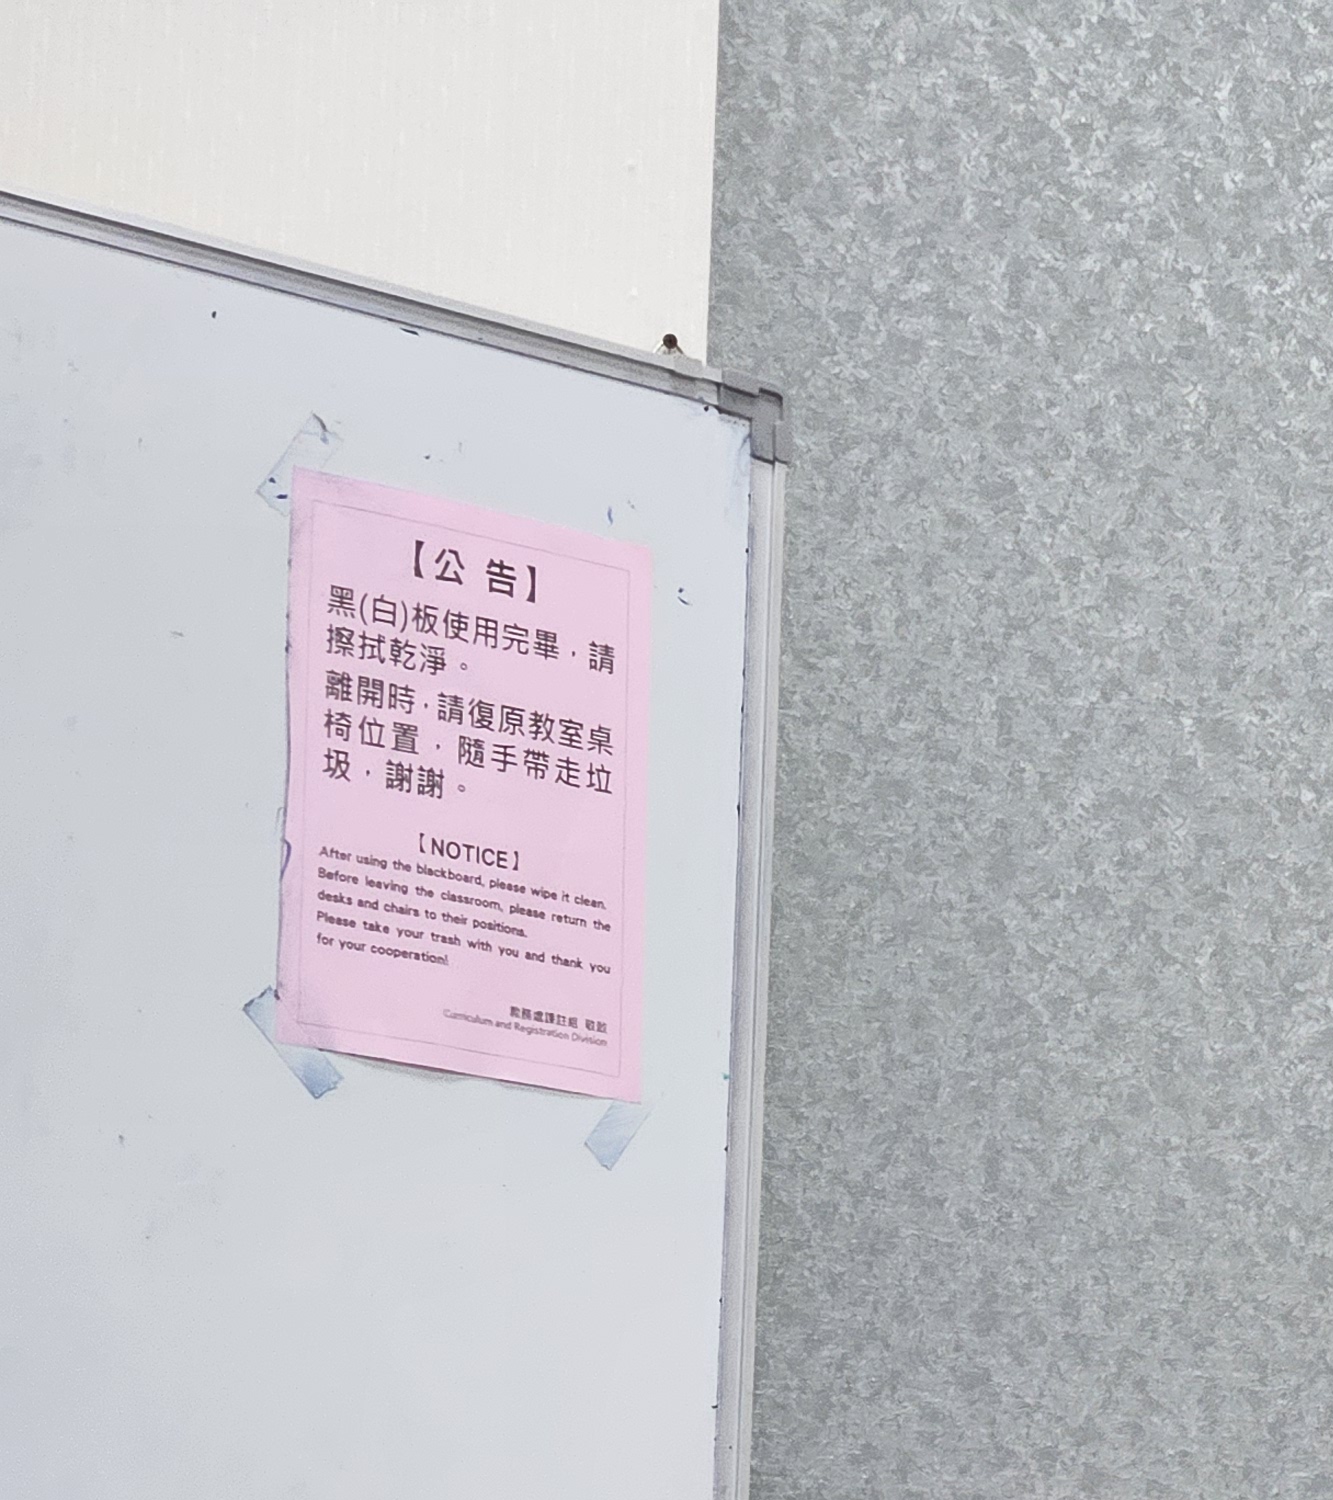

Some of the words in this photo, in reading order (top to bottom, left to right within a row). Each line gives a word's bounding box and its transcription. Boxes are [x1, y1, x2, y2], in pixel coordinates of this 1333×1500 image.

[325, 623, 468, 676] 擦拭乾淨。
[318, 867, 359, 884] Before
[365, 876, 408, 895] leaving
[415, 886, 434, 898] the
[441, 891, 504, 912] classroom,
[509, 905, 545, 919] please
[551, 913, 587, 927] return
[593, 920, 611, 932] the
[319, 846, 352, 861] After
[356, 855, 388, 869] using
[393, 859, 411, 872] the
[417, 863, 485, 886] blackboard,
[489, 879, 526, 895] please
[530, 887, 558, 901] wipe
[561, 891, 570, 902] it
[574, 894, 607, 910] clean.
[318, 890, 353, 905] desks
[357, 898, 379, 910] and
[384, 902, 419, 917] chairs
[425, 909, 437, 920] to
[442, 912, 468, 925] their
[473, 918, 527, 938] positions.
[317, 911, 356, 928] Please
[363, 921, 389, 934] take
[396, 927, 424, 940] your
[431, 932, 461, 946] trash
[467, 939, 492, 952] with
[498, 946, 519, 959] you
[525, 950, 545, 962] and
[551, 955, 583, 969] thank
[590, 963, 610, 975] you
[317, 933, 334, 946] for
[339, 940, 367, 953] your
[371, 944, 449, 965] cooperation!
[443, 1009, 493, 1027] Curriculum
[495, 1020, 512, 1030] and
[514, 1022, 569, 1040] Registration
[572, 1034, 607, 1047] Division
